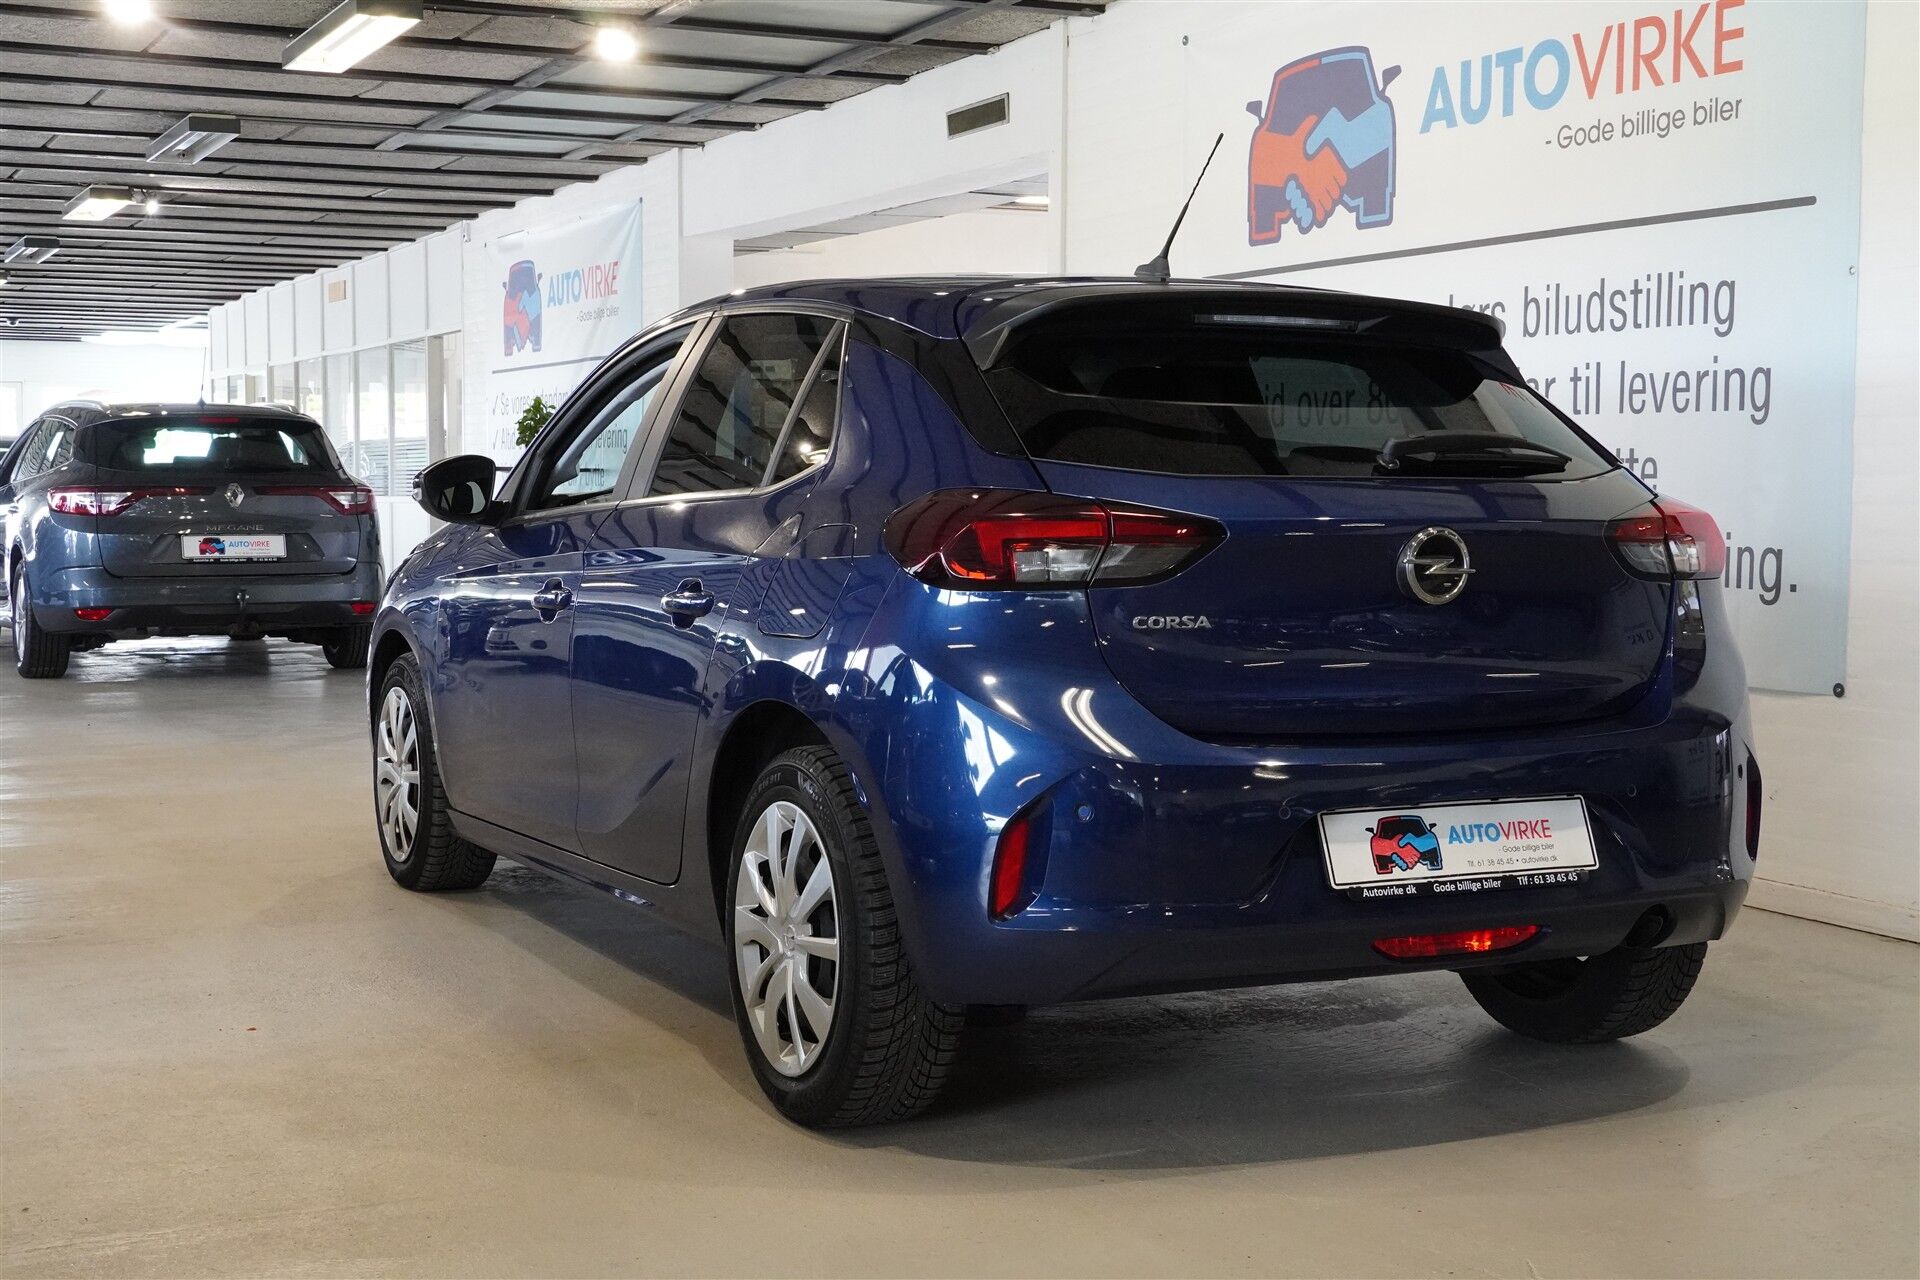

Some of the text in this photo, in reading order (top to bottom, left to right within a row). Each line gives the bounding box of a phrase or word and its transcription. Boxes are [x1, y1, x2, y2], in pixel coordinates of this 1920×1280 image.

[1419, 0, 1745, 134] AUTOVIRKE
[1557, 119, 1614, 149] Gode
[1621, 107, 1686, 138] billige
[1694, 97, 1743, 127] biler
[547, 261, 619, 308] AUTOVIRKE
[1522, 270, 1736, 338] biludstilling
[1297, 389, 1355, 428] over
[1570, 361, 1600, 415] til
[1619, 355, 1772, 426] levering
[228, 540, 270, 548] AUTOVIRKE
[1132, 615, 1212, 629] CORSA
[1448, 819, 1552, 844] AUTOVIRKE
[1502, 844, 1521, 853] Gode
[1362, 886, 1404, 898] Autovirke
[1433, 882, 1455, 892] Gode
[1457, 880, 1482, 892] billige
[1483, 878, 1502, 889] biler
[1534, 875, 1544, 884] 61
[1545, 873, 1556, 883] 38
[1557, 872, 1567, 882] 45
[1568, 872, 1578, 882] 45
